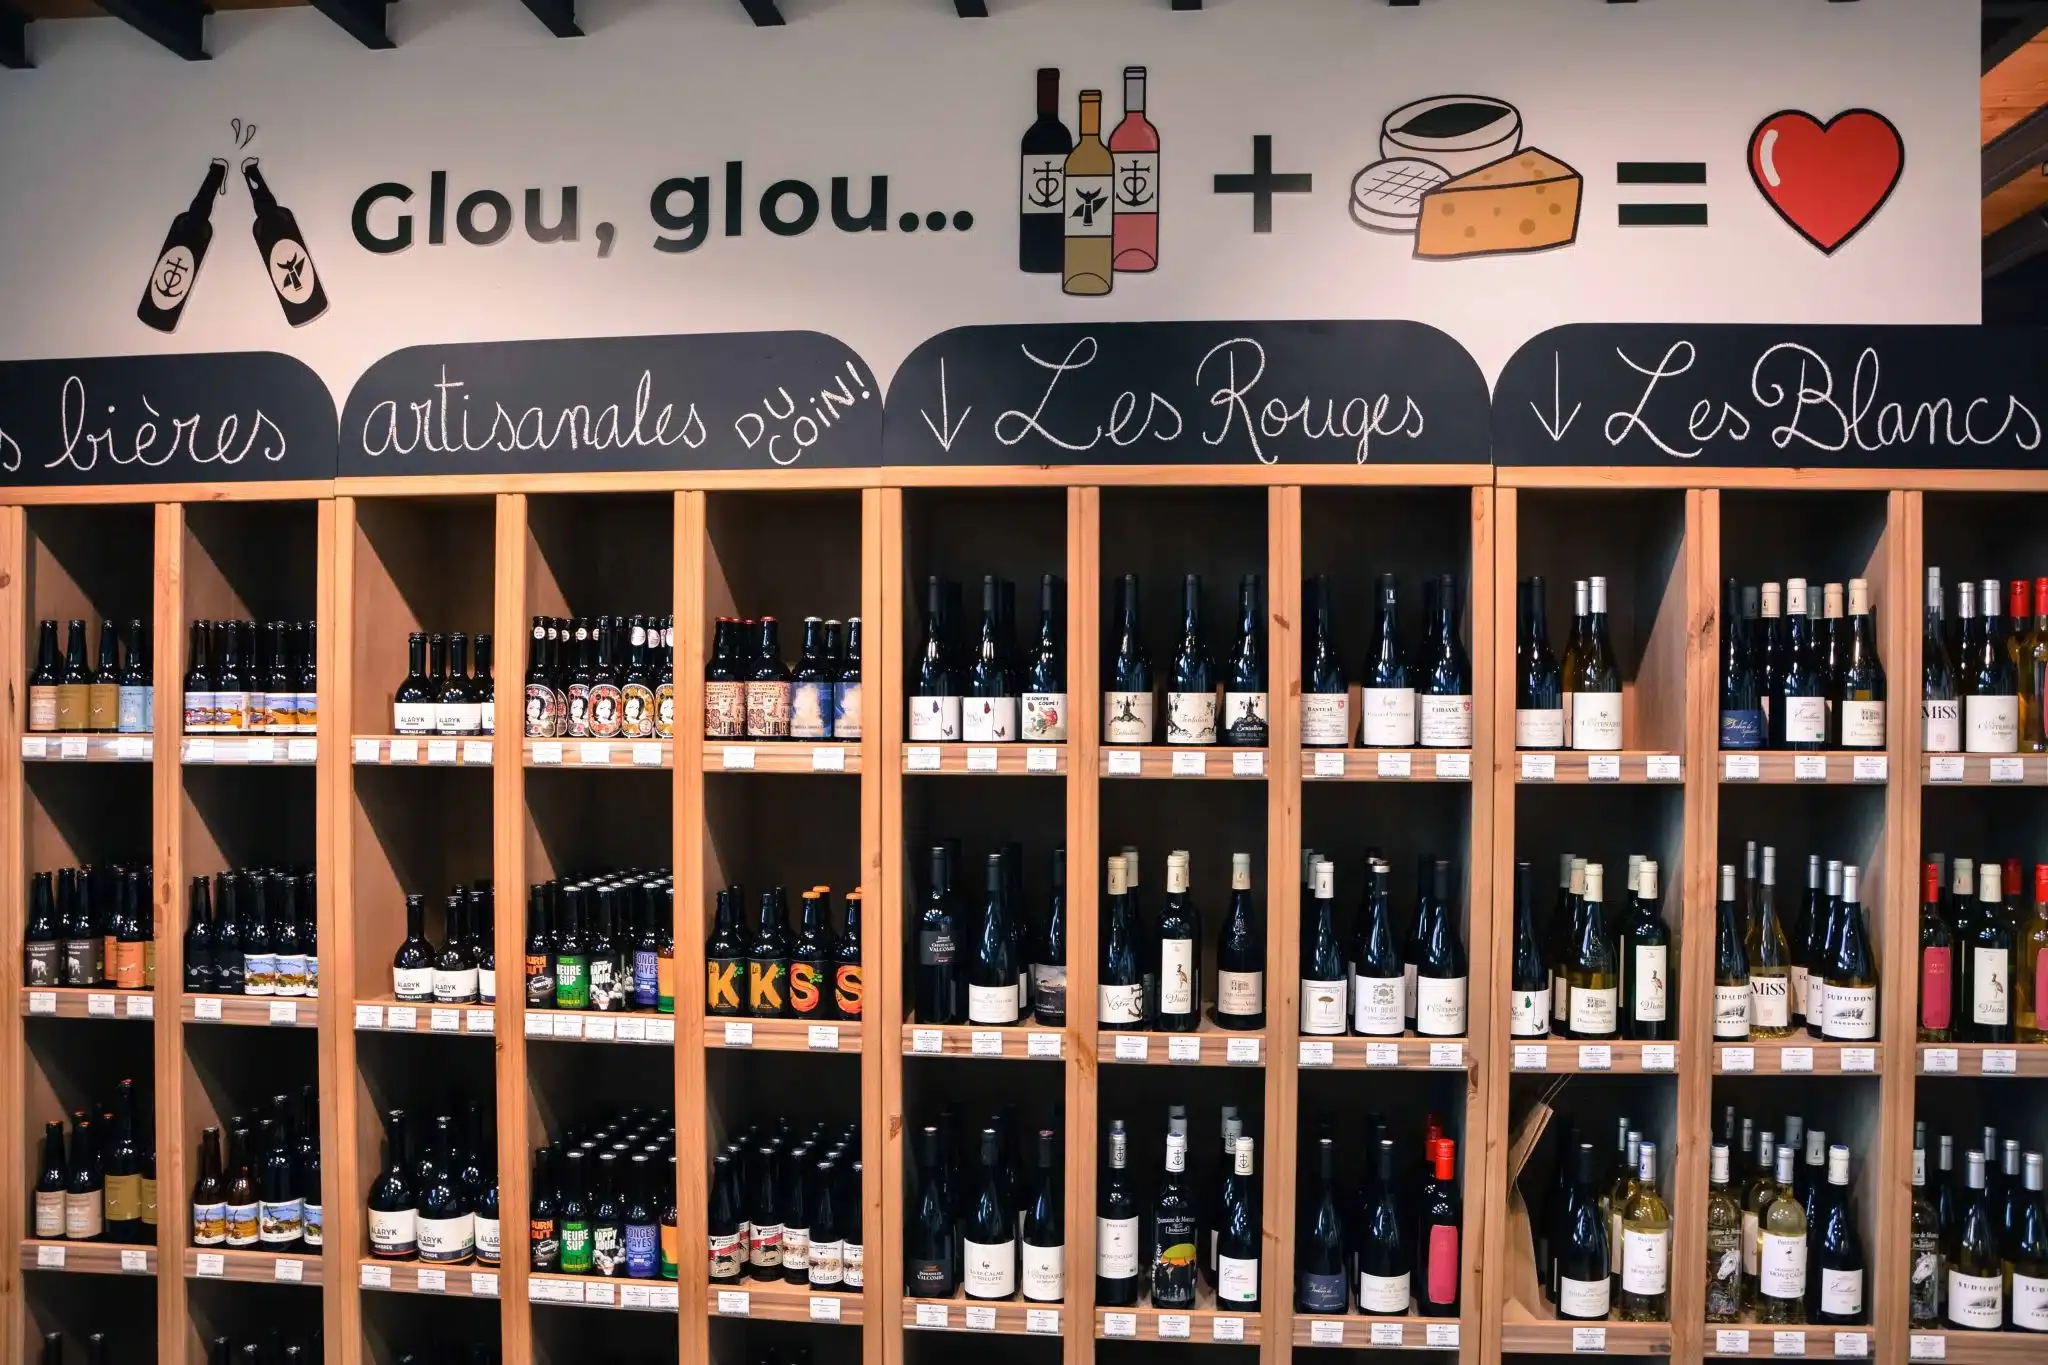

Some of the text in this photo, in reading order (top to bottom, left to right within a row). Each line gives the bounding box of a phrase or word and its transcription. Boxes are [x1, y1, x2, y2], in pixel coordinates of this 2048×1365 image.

[351, 161, 974, 258] Glou, glou...
[995, 336, 1424, 465] Les Rouges
[1605, 340, 2041, 458] Les Blancs
[363, 364, 706, 455] artisanales
[735, 387, 794, 448] DU
[45, 376, 286, 471] bières
[559, 975, 576, 986] SUP
[435, 983, 456, 991] ALARYK
[372, 1227, 397, 1236] ALARYK
[562, 1229, 589, 1240] HEURE
[594, 1229, 617, 1241] HAPPY
[480, 1235, 500, 1243] ALAR
[595, 1239, 616, 1250] HOUR
[566, 1241, 584, 1251] SUP
